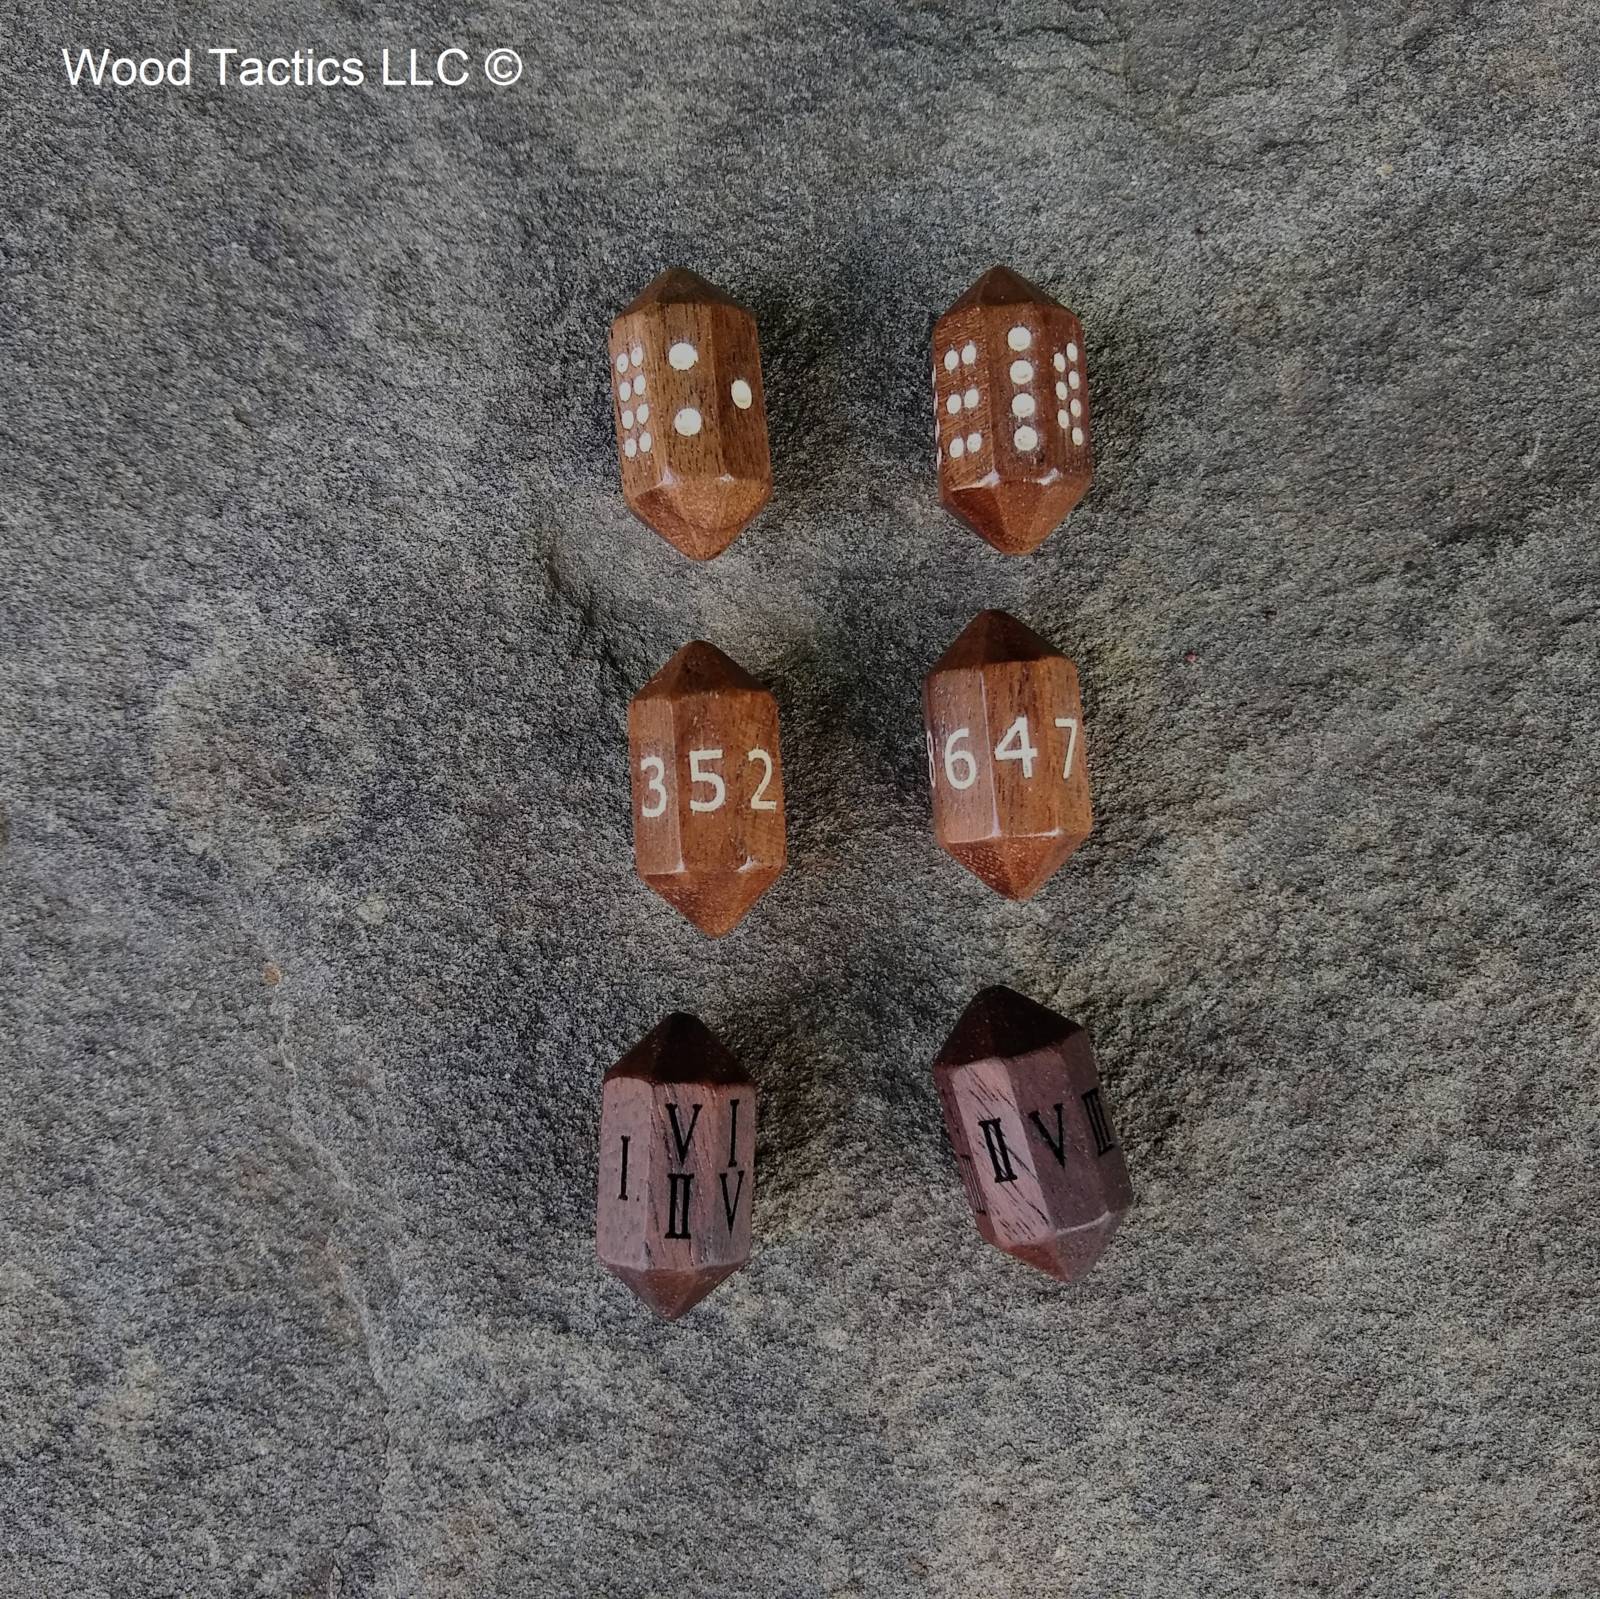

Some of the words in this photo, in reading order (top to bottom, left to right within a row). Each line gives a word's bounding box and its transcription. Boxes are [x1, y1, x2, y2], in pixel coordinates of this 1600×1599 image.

[640, 755, 668, 818] 3
[689, 749, 726, 813] 5
[748, 749, 777, 811] 2
[926, 730, 936, 789] 8
[944, 728, 977, 790] 6
[994, 716, 1038, 779] 4
[1054, 717, 1078, 780] 7
[665, 1102, 702, 1167] V
[978, 1117, 1018, 1184] II
[1027, 1102, 1066, 1169] V
[719, 1169, 745, 1234] V
